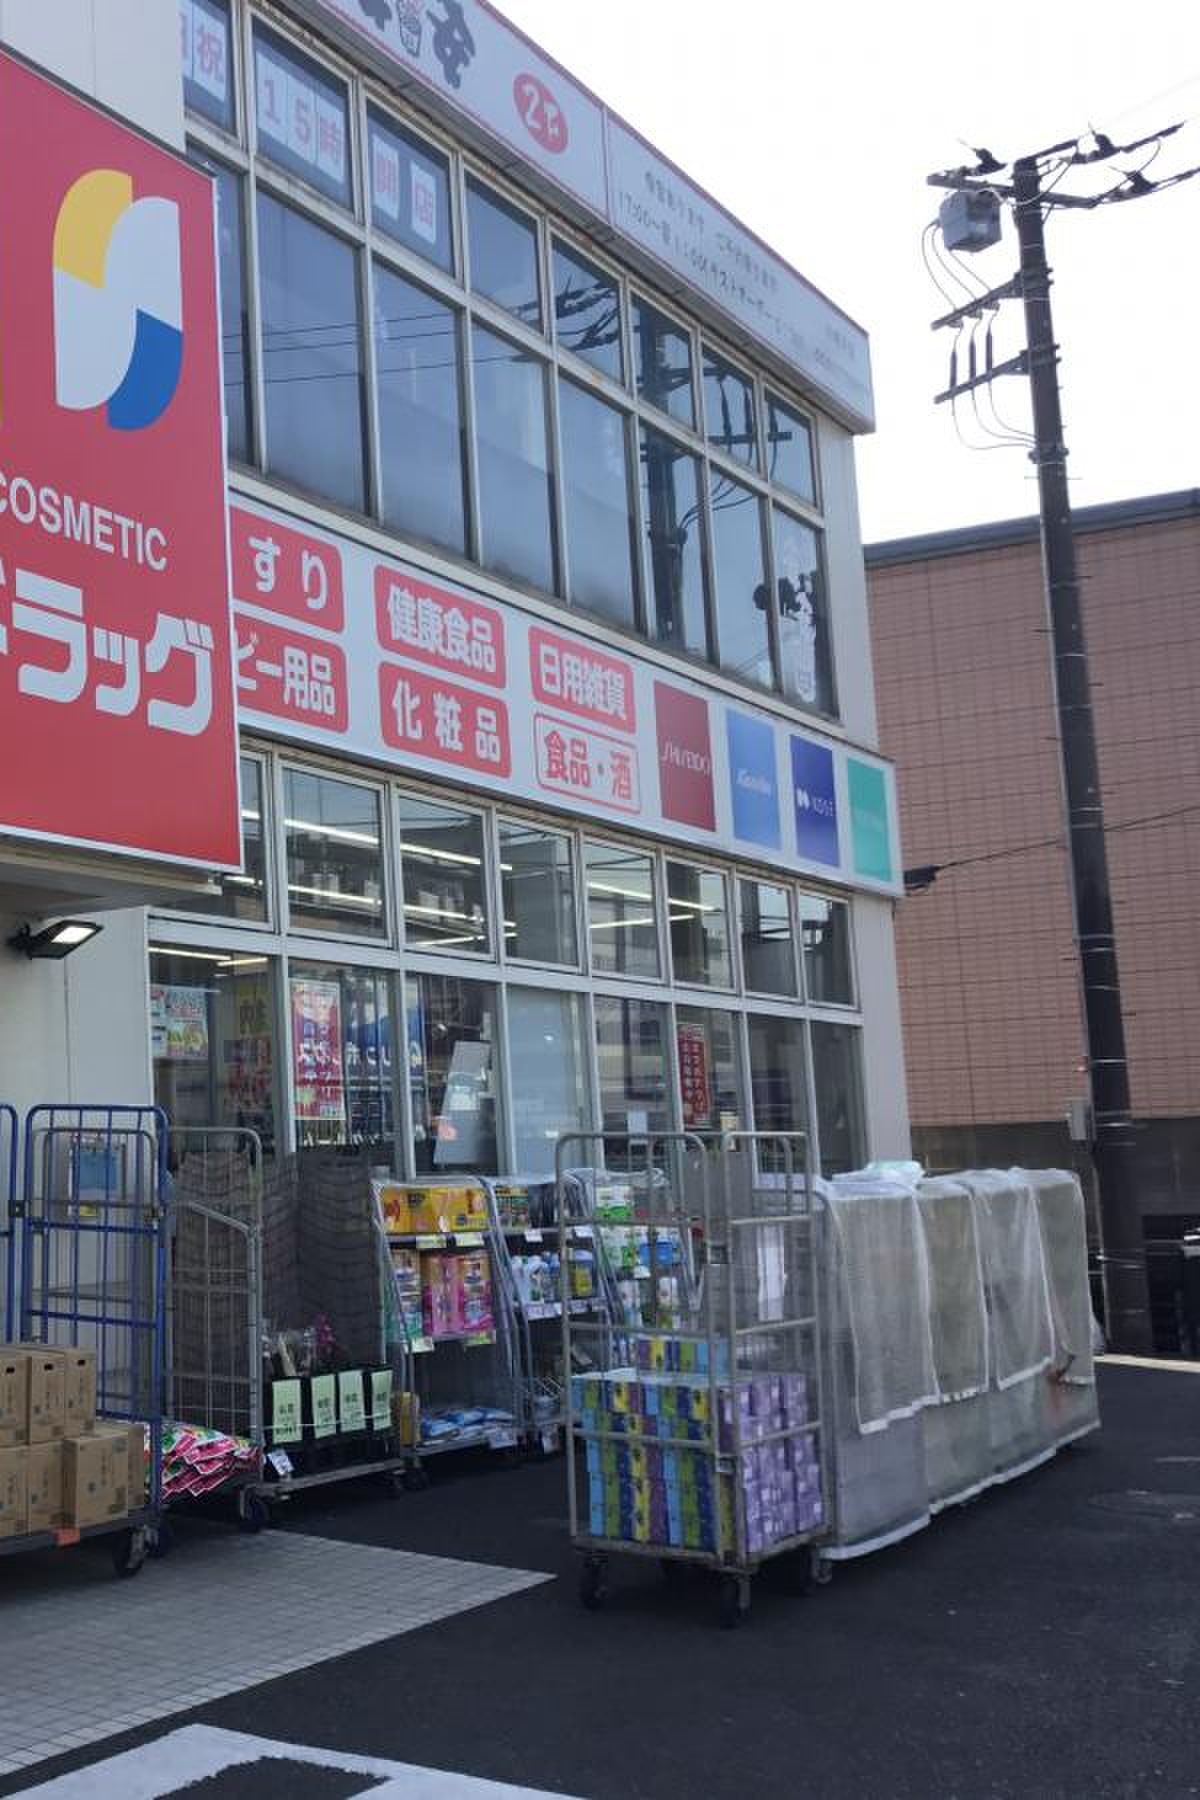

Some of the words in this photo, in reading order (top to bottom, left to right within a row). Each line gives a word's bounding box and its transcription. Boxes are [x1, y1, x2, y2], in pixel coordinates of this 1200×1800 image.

[263, 79, 343, 156] 15時
[247, 534, 328, 609] すり
[388, 582, 497, 675] 健康食品
[391, 680, 501, 764] 化粧品
[538, 650, 626, 722] 日用雑貨
[543, 729, 632, 800] 食品・酒
